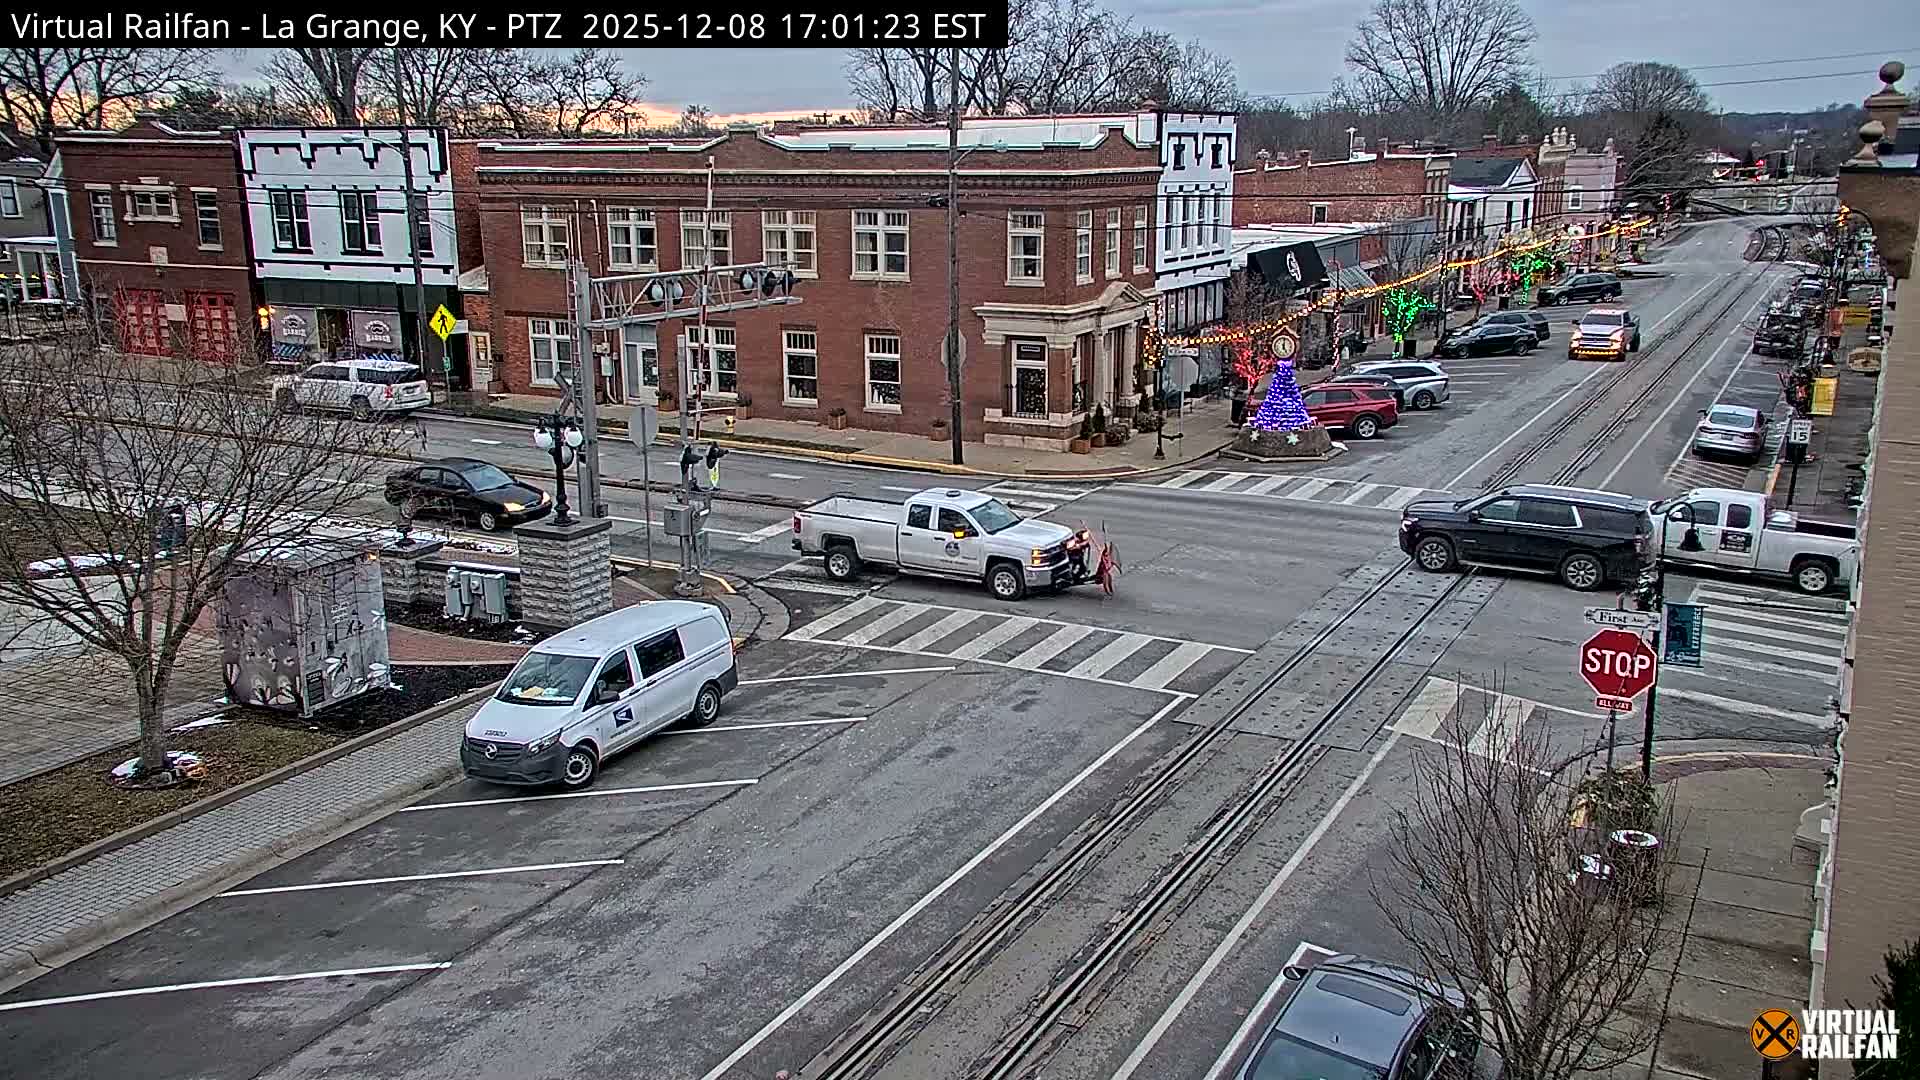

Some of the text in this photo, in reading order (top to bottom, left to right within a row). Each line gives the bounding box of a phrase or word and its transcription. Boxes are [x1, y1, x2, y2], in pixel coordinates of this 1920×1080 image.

[1794, 432, 1808, 441] 15
[1600, 611, 1627, 624] First
[1585, 648, 1650, 678] STOP
